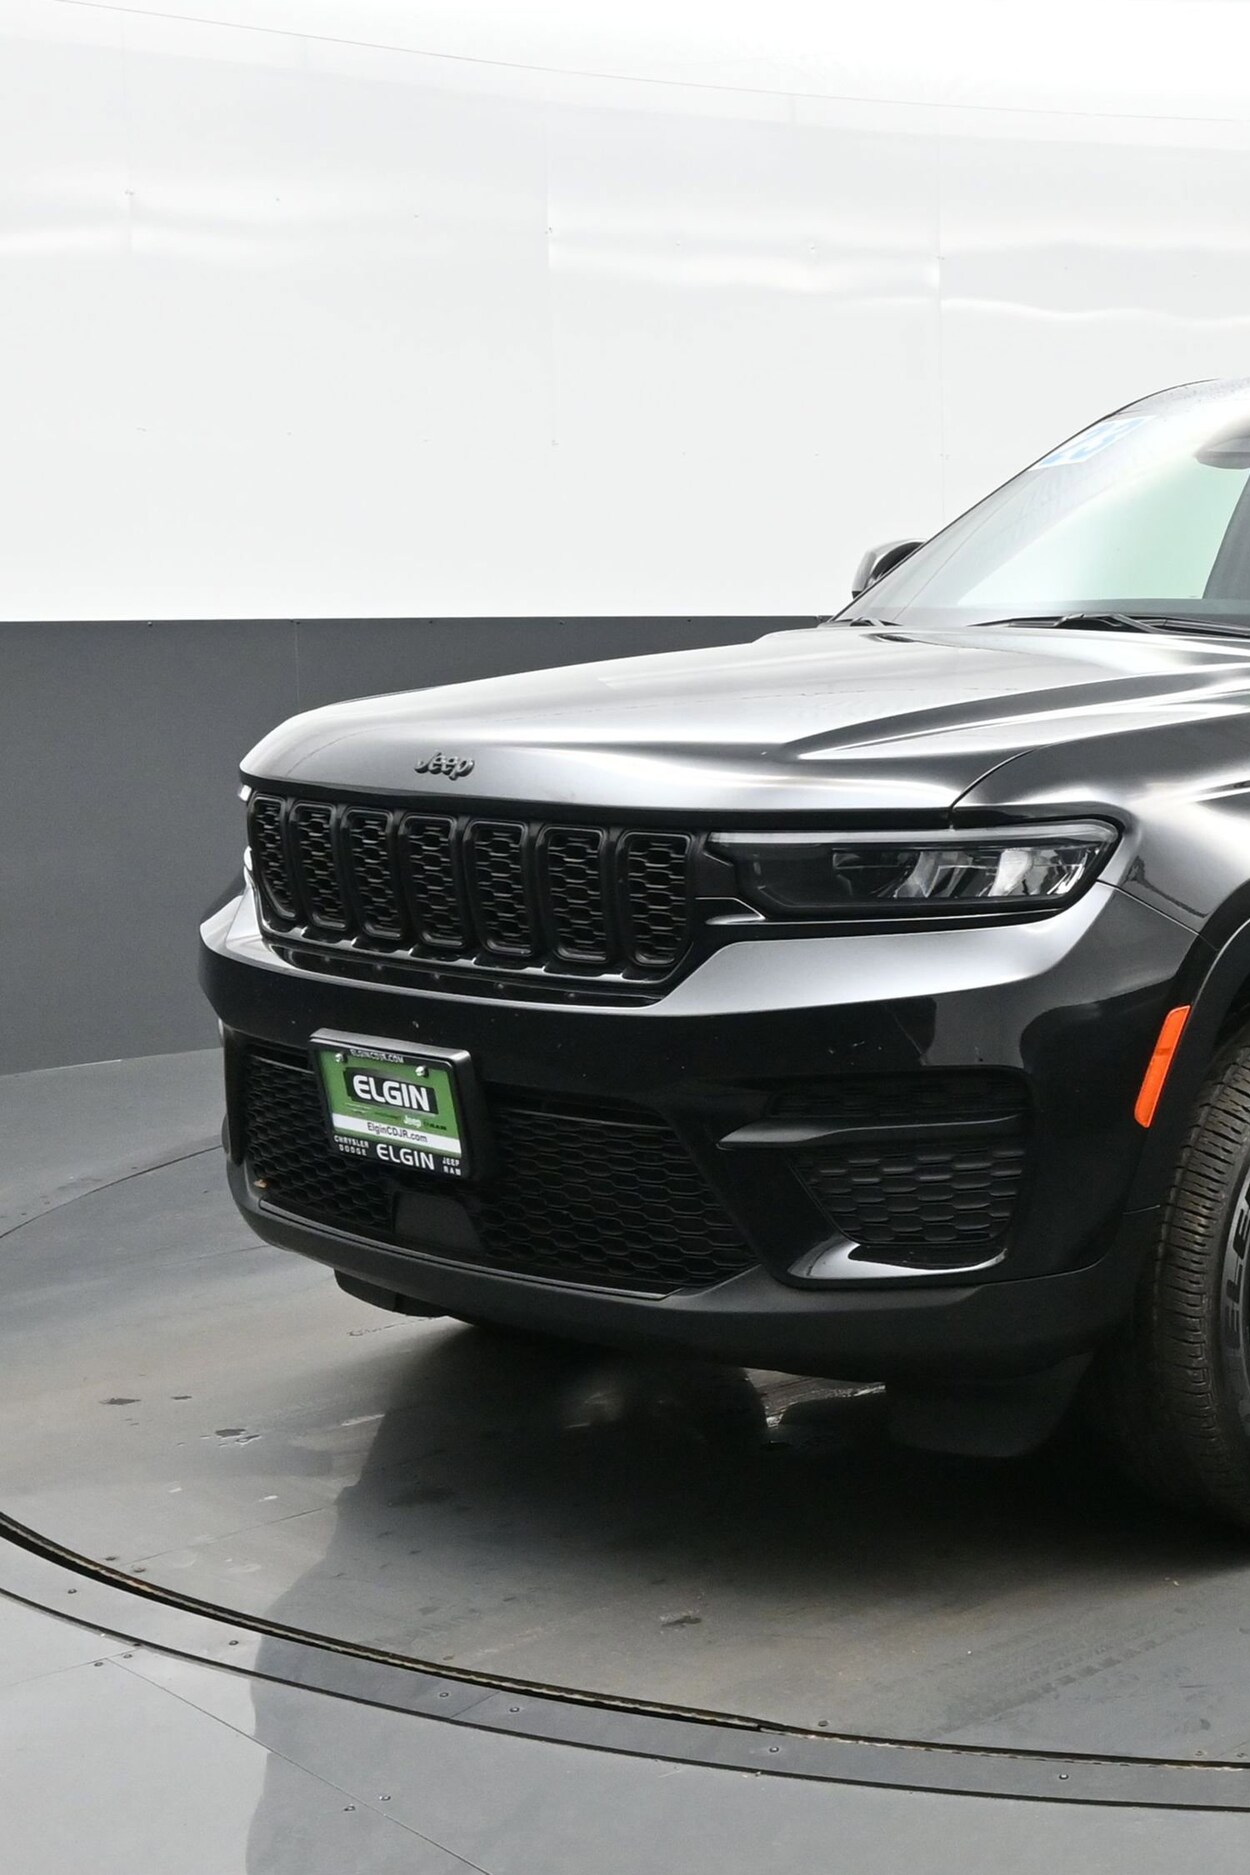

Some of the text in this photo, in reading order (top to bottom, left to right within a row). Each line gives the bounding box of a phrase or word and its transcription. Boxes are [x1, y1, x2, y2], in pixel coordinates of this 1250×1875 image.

[414, 751, 475, 781] Jeep
[352, 1073, 431, 1112] ELGIN
[334, 1134, 369, 1148] CHRYSLER
[367, 1121, 428, 1143] ElginCDJR.com
[338, 1143, 367, 1156] DODGE
[375, 1143, 435, 1171] ELGIN
